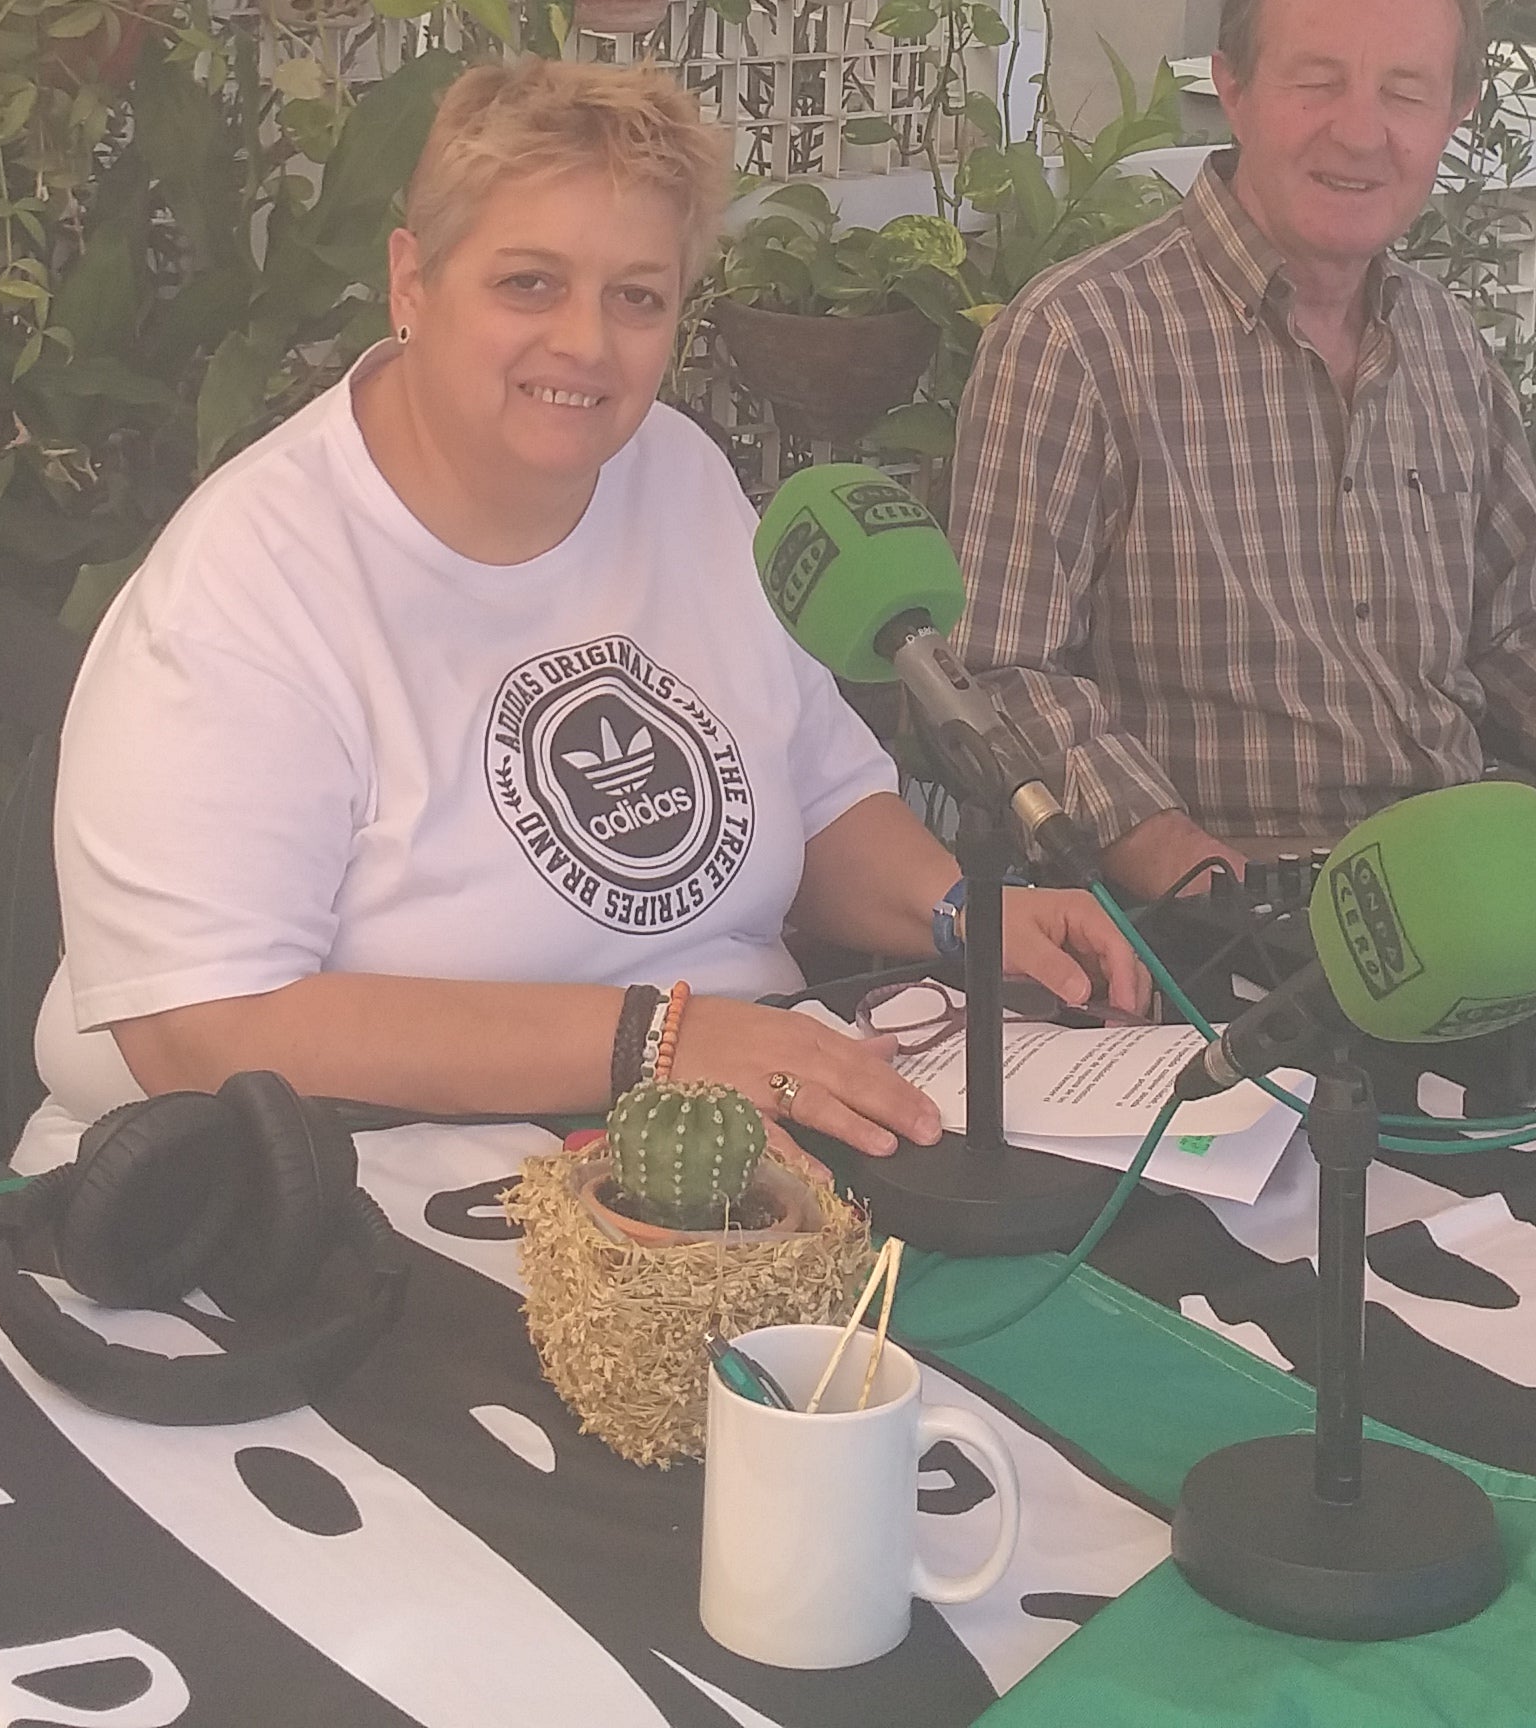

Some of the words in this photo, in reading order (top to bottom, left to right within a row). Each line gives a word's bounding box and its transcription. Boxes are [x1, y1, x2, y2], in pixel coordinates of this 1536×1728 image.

[785, 546, 822, 603] CERO
[495, 671, 544, 754] ADIDAS
[538, 640, 677, 701] ORIGINALS
[713, 744, 748, 805] THE
[589, 785, 693, 841] adidas
[516, 811, 602, 907] BRAND
[604, 877, 705, 927] STRIPES
